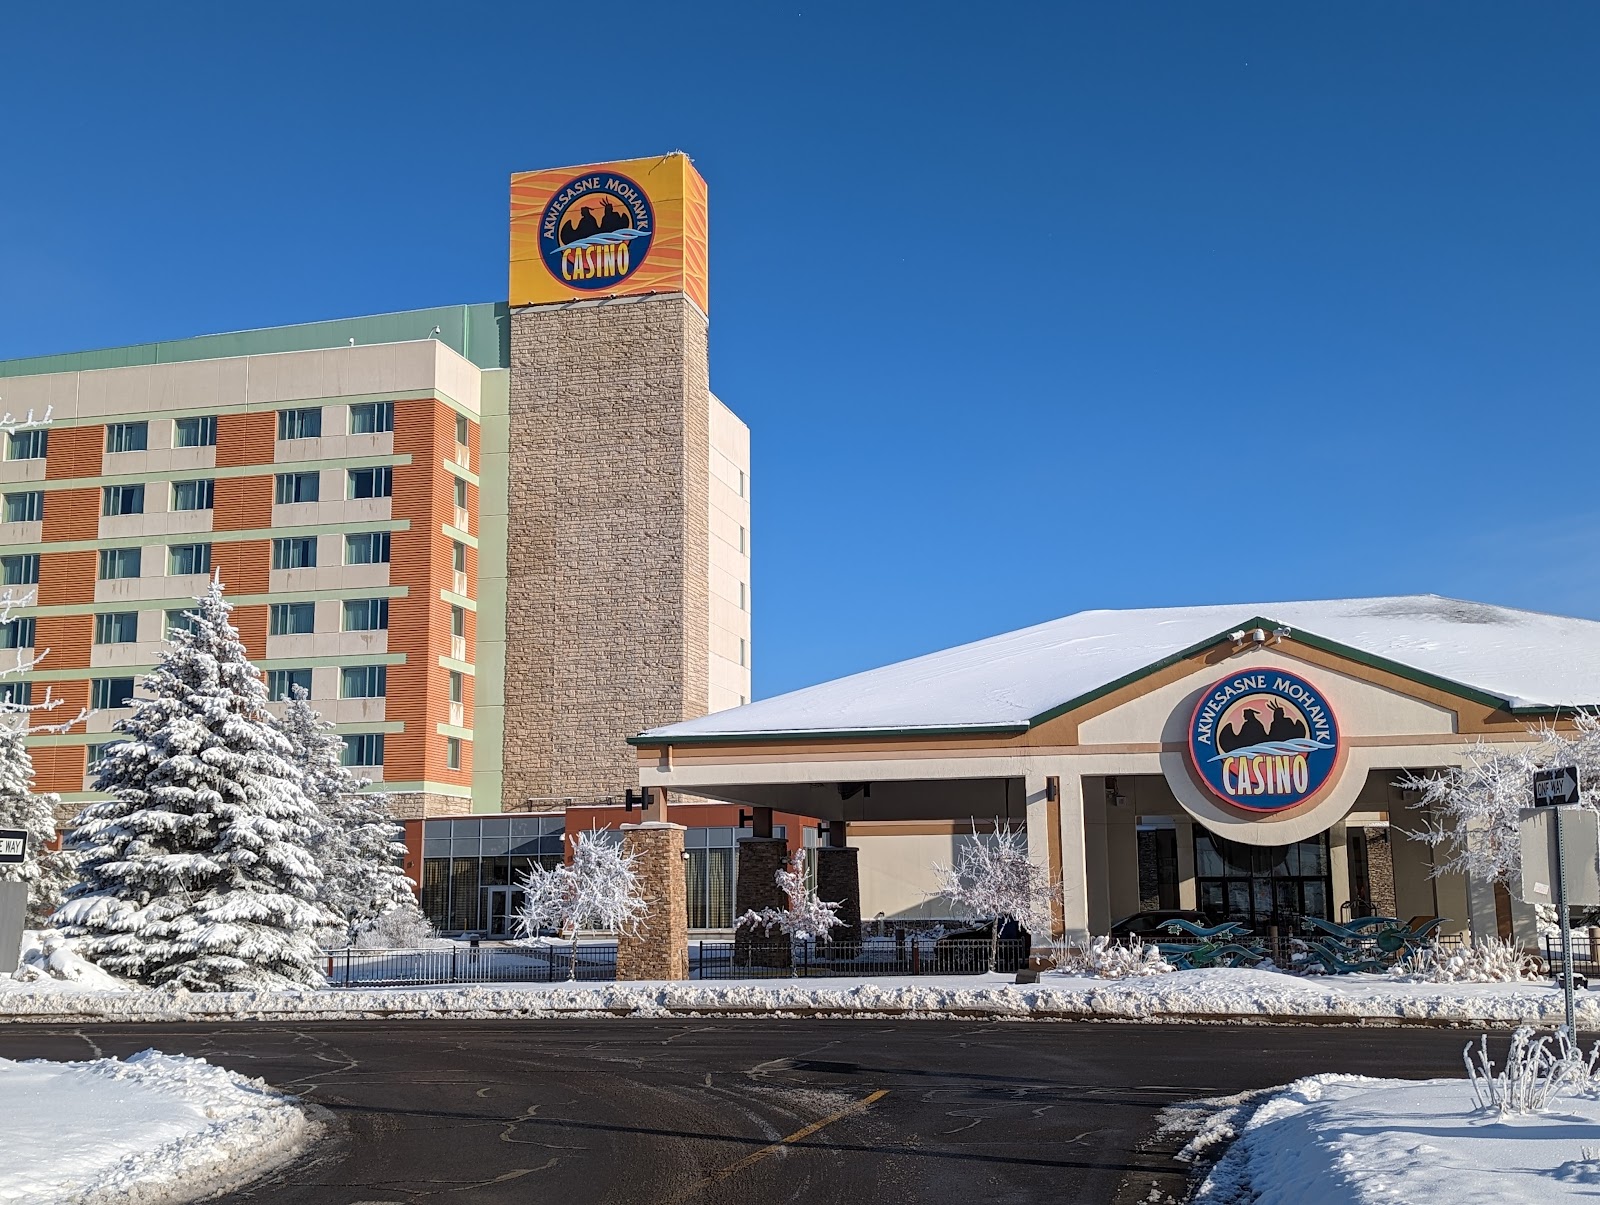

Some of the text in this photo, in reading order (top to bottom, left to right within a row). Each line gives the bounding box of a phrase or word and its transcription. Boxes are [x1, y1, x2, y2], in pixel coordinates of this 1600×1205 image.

[544, 177, 648, 239] AKWESASNE MOHAWK
[561, 243, 630, 281] CASINO
[1197, 675, 1331, 745] AKWESASNE MOHAWK
[1223, 755, 1308, 795] CASINO
[1550, 779, 1564, 794] WAY
[5, 840, 21, 853] WAY
